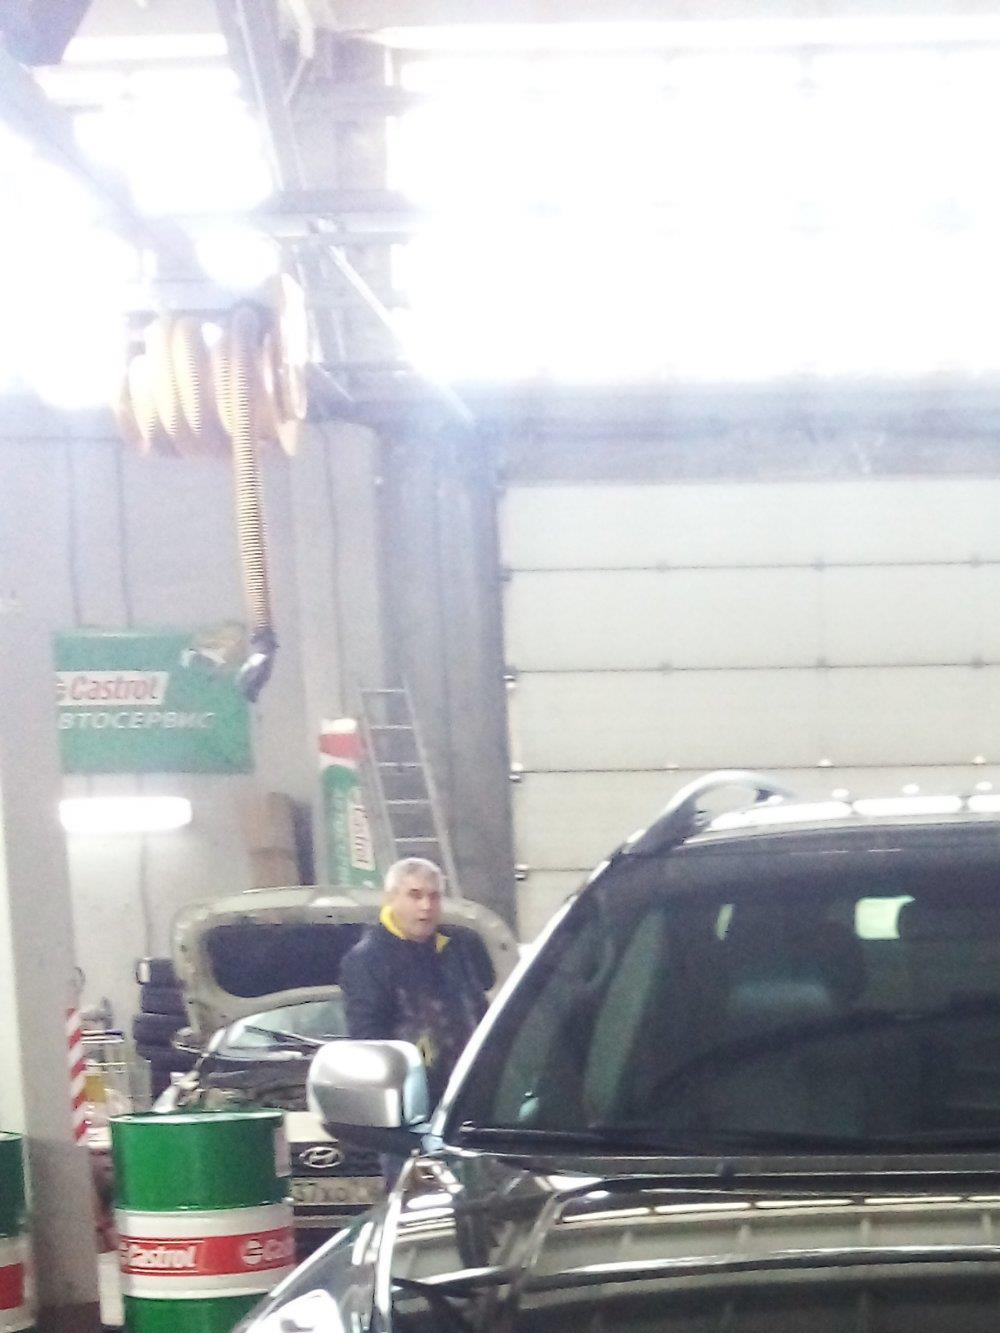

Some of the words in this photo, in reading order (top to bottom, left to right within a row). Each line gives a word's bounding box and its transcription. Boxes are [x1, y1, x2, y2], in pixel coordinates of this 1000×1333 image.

[71, 675, 159, 700] Castrol
[58, 711, 217, 729] ВТОСЕРВИС
[128, 1244, 197, 1268] Castrol
